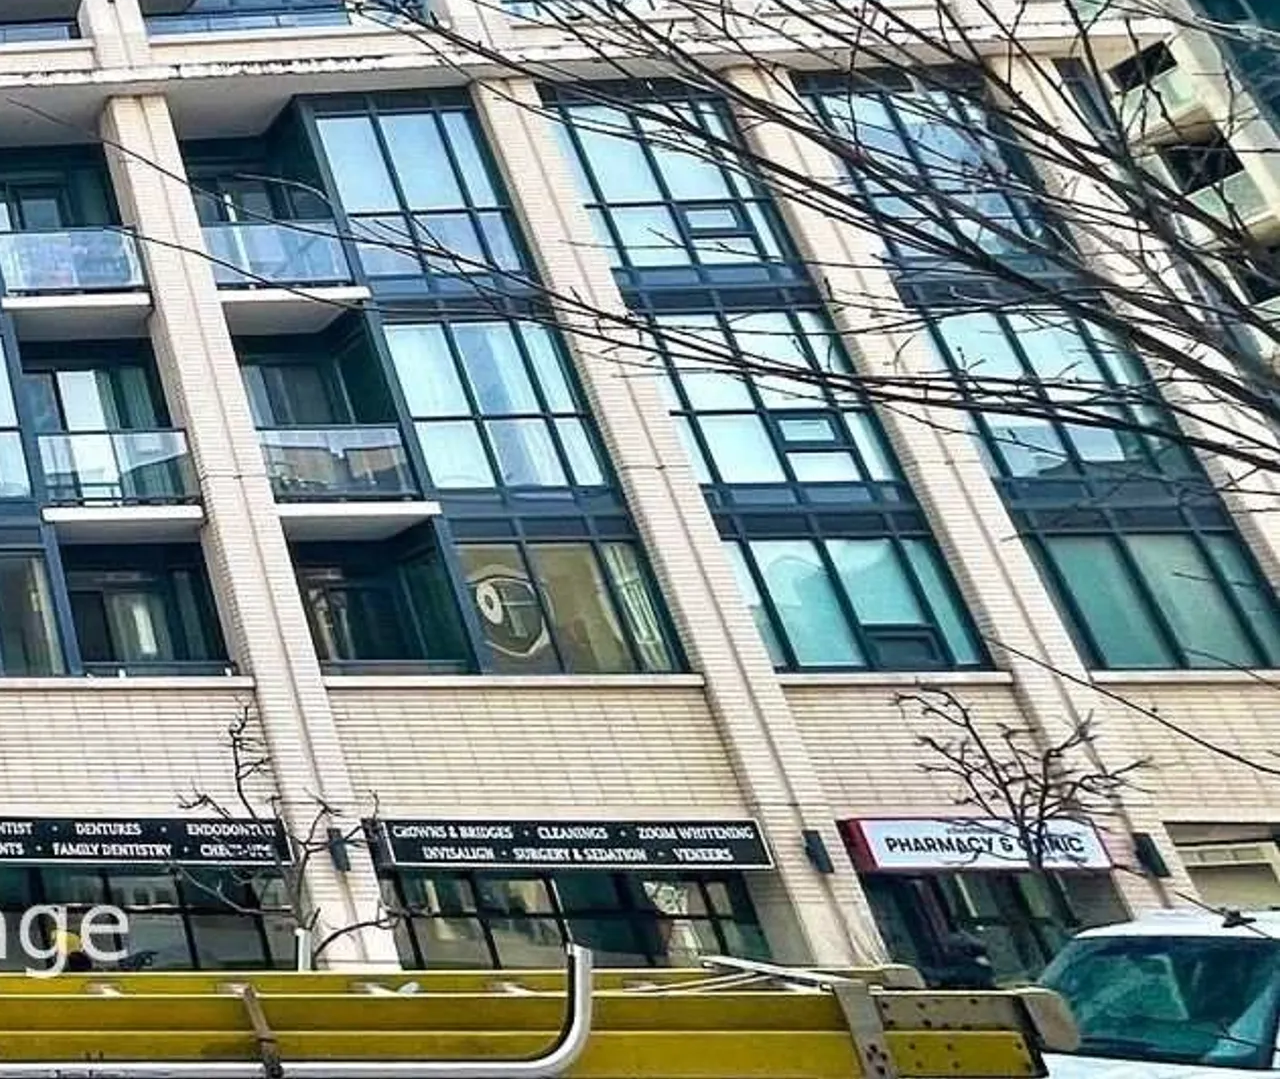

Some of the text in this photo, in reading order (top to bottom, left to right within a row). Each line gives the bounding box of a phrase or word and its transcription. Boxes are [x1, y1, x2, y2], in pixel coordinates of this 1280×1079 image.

[75, 823, 142, 836] DENTURES
[393, 826, 447, 839] CROWNS
[460, 826, 513, 839] BRIDGES
[537, 826, 608, 839] CLEANINGS
[638, 826, 676, 839] ZOOM
[678, 826, 754, 840] WHITENING
[52, 842, 99, 856] FAMILY
[102, 842, 173, 857] DENTISTRY
[885, 837, 1086, 853] PHARMACY & CINIC
[422, 847, 495, 860] INVISALIGN
[513, 847, 570, 860] SURGERY
[584, 848, 647, 861] SEDATION
[672, 847, 733, 862] VENEERS
